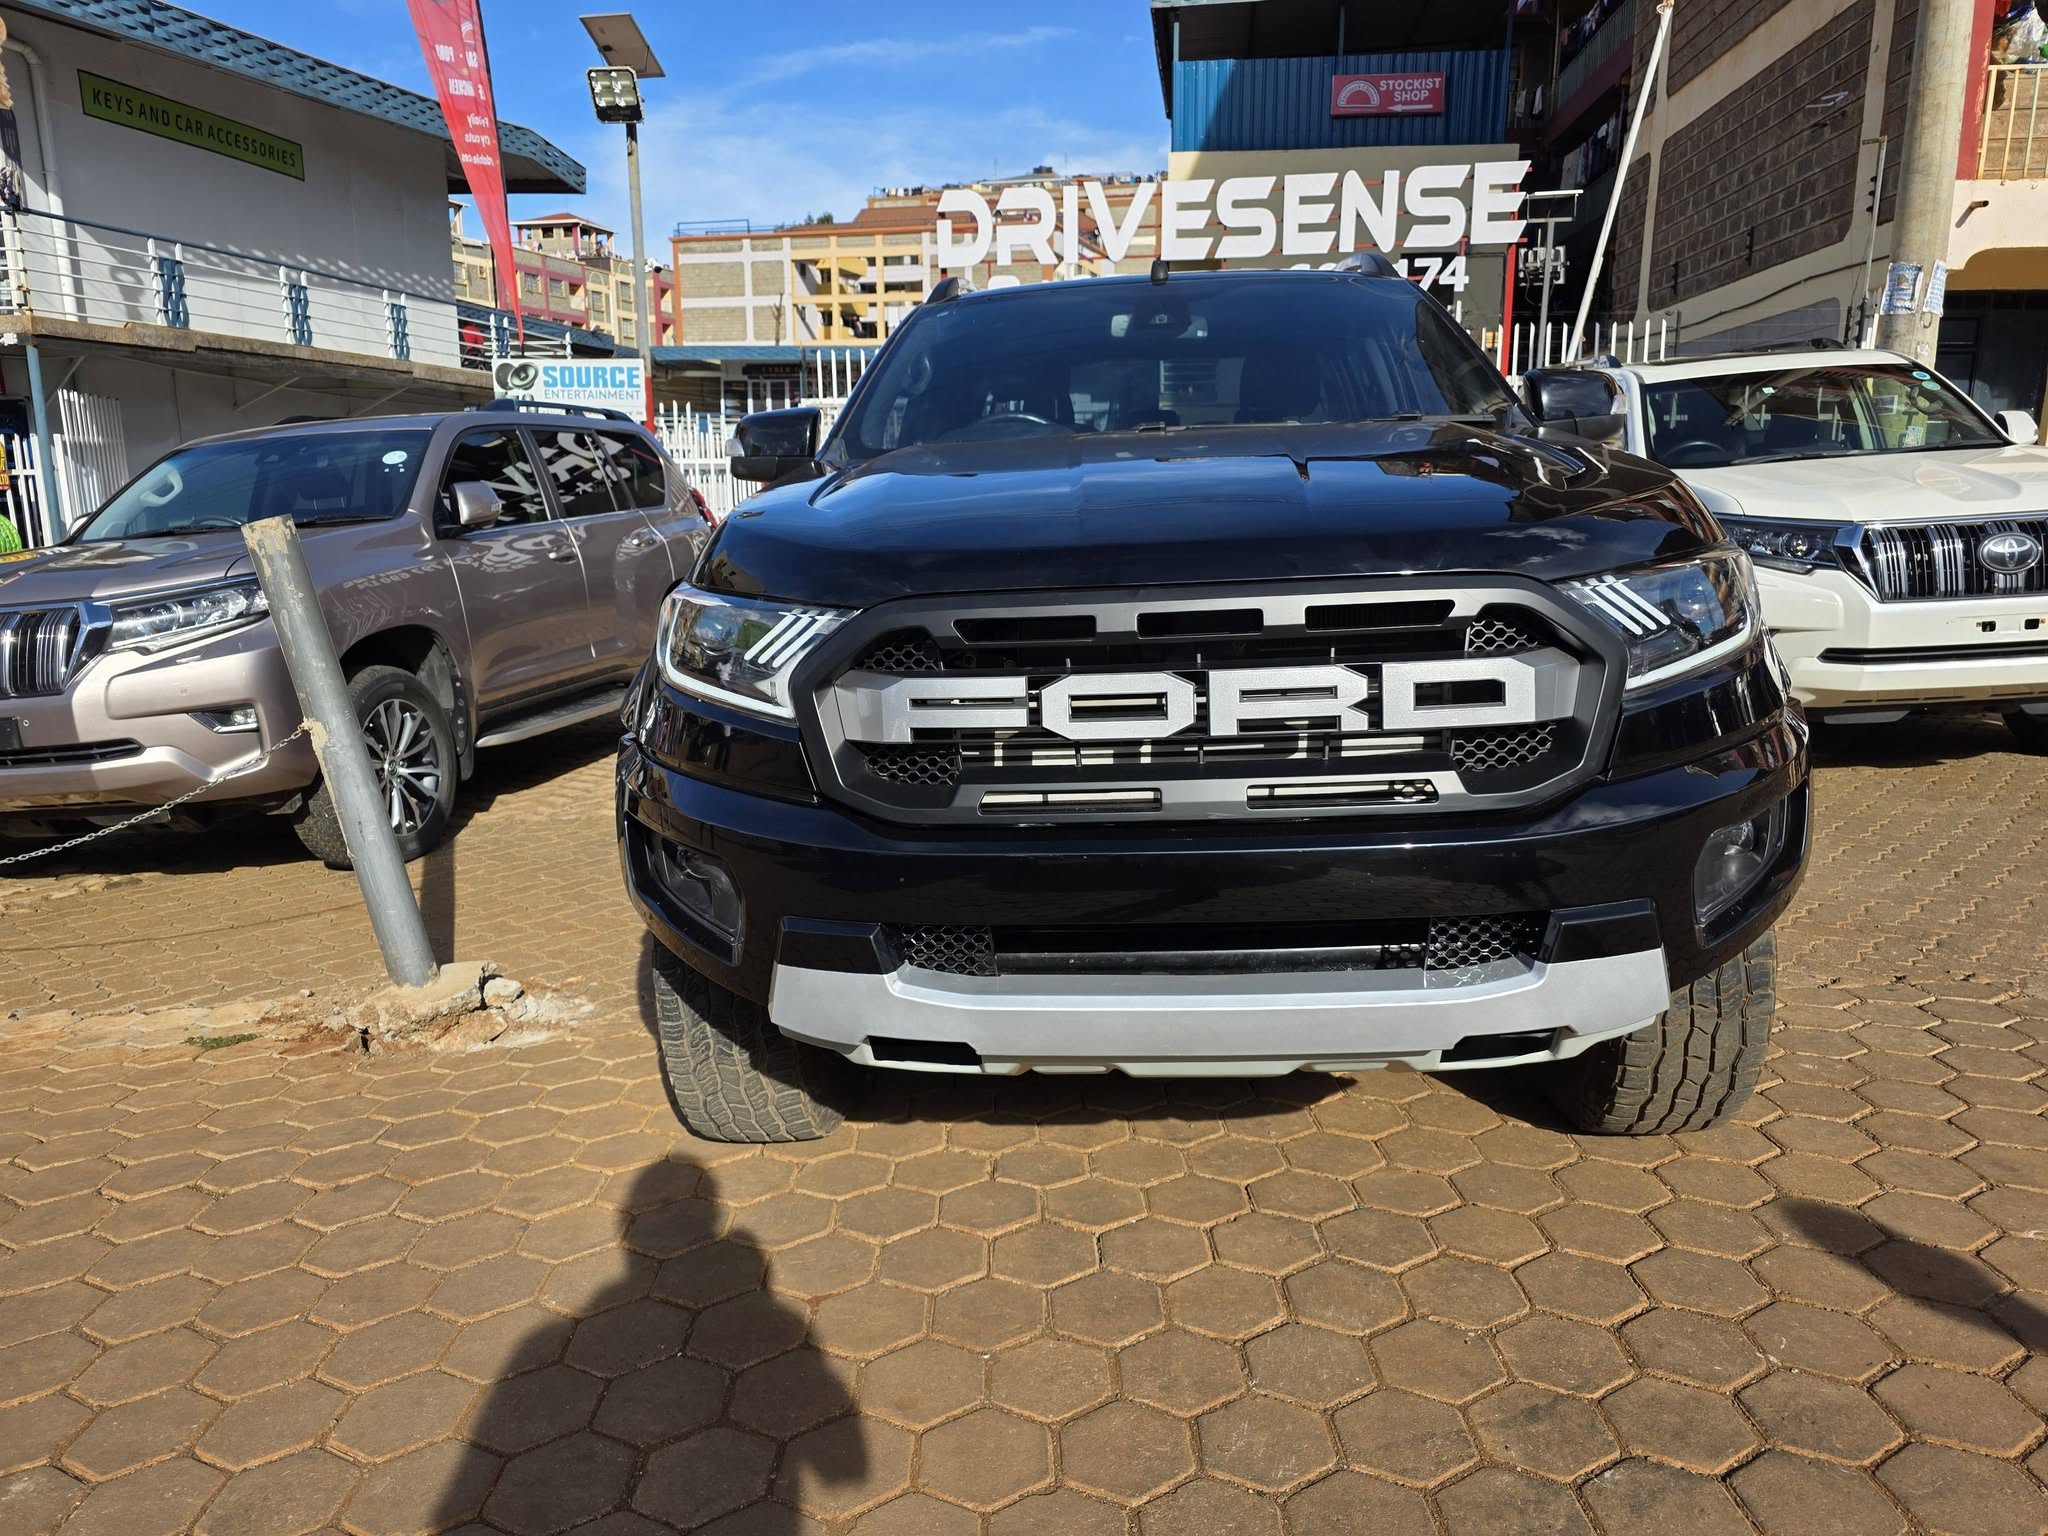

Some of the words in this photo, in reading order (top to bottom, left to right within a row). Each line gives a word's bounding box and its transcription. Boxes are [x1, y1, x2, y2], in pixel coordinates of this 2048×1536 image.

[1379, 77, 1442, 91] STOCKIST
[1393, 90, 1430, 102] SHOP
[92, 87, 134, 116] KEYS
[138, 103, 171, 127] AND
[175, 114, 204, 137] CAR
[207, 124, 296, 168] ACCESSORIES
[936, 159, 1532, 268] DRIVESENSE
[542, 365, 641, 389] SOURCE
[544, 389, 641, 401] ENTERTAINMENT
[896, 656, 1538, 745] FORD
